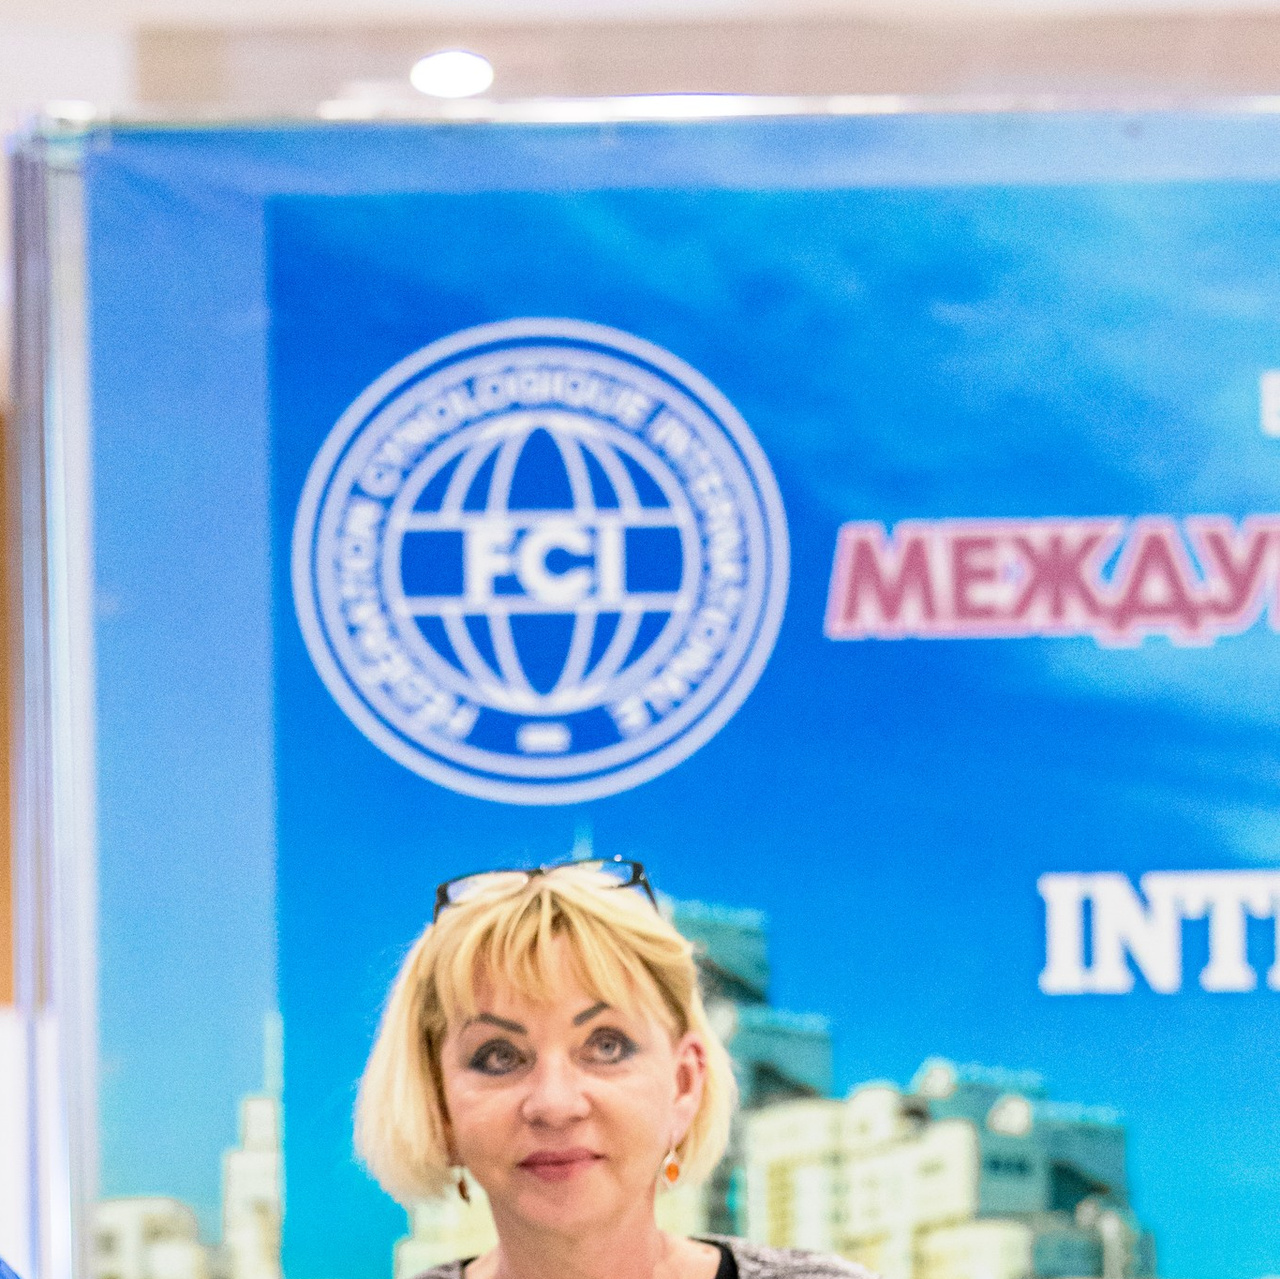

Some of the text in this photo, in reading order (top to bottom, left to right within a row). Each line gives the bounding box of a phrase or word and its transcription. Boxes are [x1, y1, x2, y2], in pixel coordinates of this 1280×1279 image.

[463, 517, 627, 606] FCI
[825, 516, 1280, 648] МЕЖДУ
[1036, 869, 1280, 995] INT
